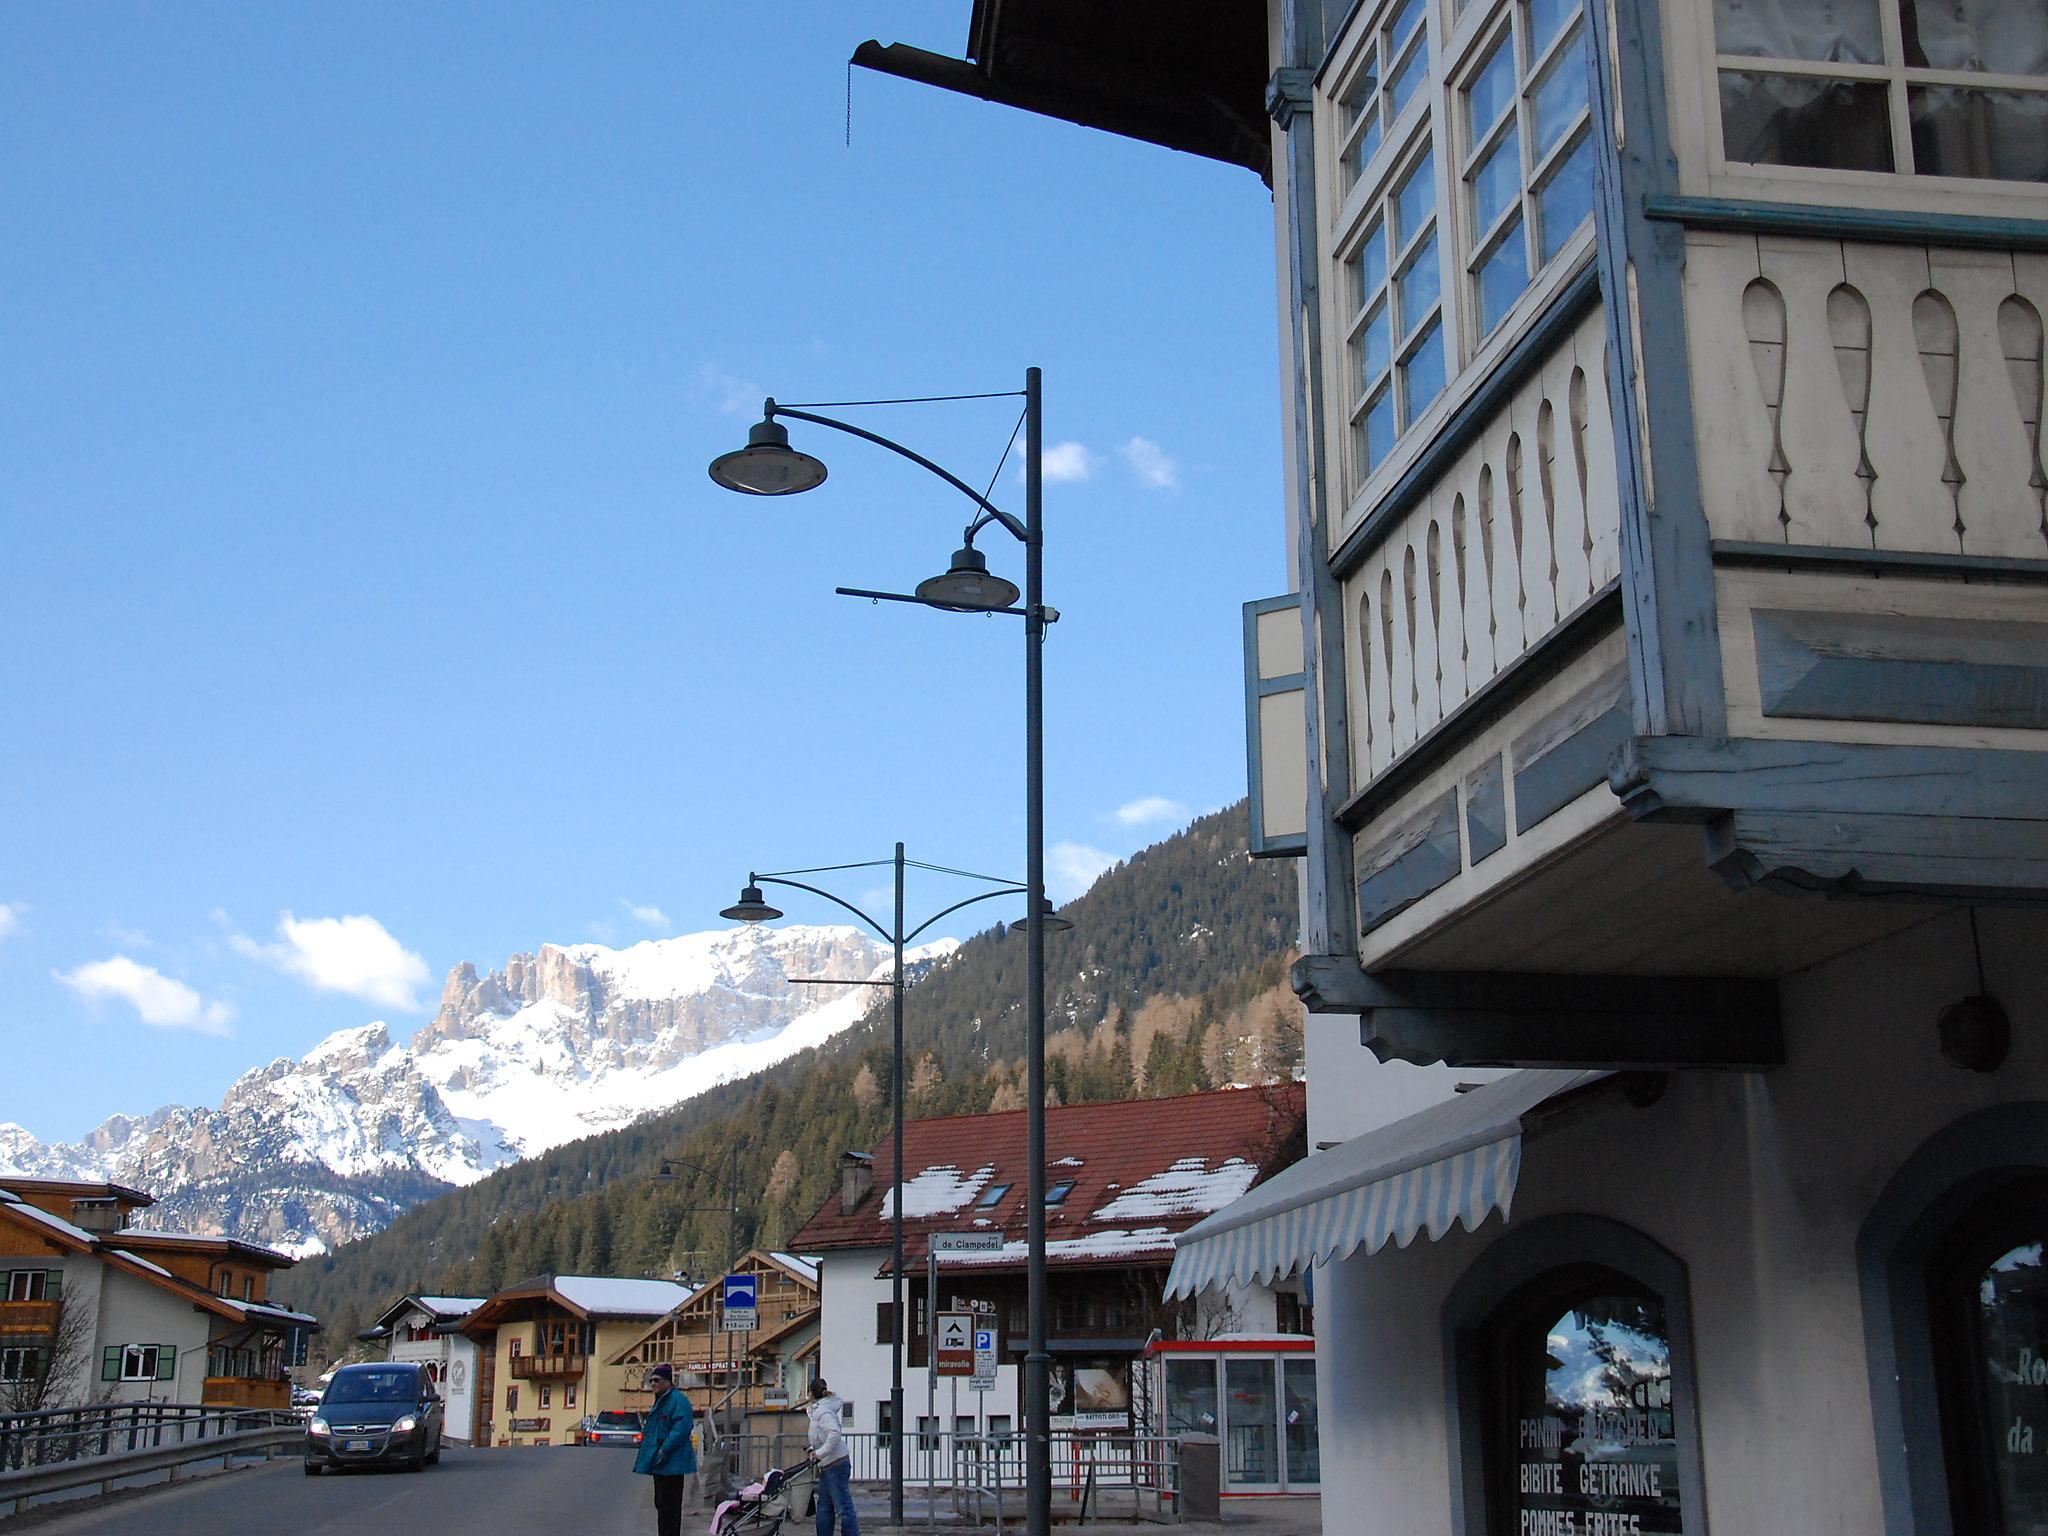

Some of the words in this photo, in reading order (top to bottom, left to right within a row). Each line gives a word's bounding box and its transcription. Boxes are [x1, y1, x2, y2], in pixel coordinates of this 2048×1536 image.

[942, 1241, 952, 1249] de
[956, 1240, 998, 1250] Ciampedel
[977, 1333, 988, 1348] P
[938, 1360, 970, 1368] miravalle
[2018, 1347, 2048, 1385] Ro
[1520, 1418, 1562, 1448] PANINI
[2007, 1416, 2033, 1454] da
[1520, 1464, 1563, 1494] BIBITE
[1580, 1463, 1662, 1497] GETRANKE
[1521, 1509, 1575, 1536] POMMES
[1585, 1512, 1640, 1536] FRITES
